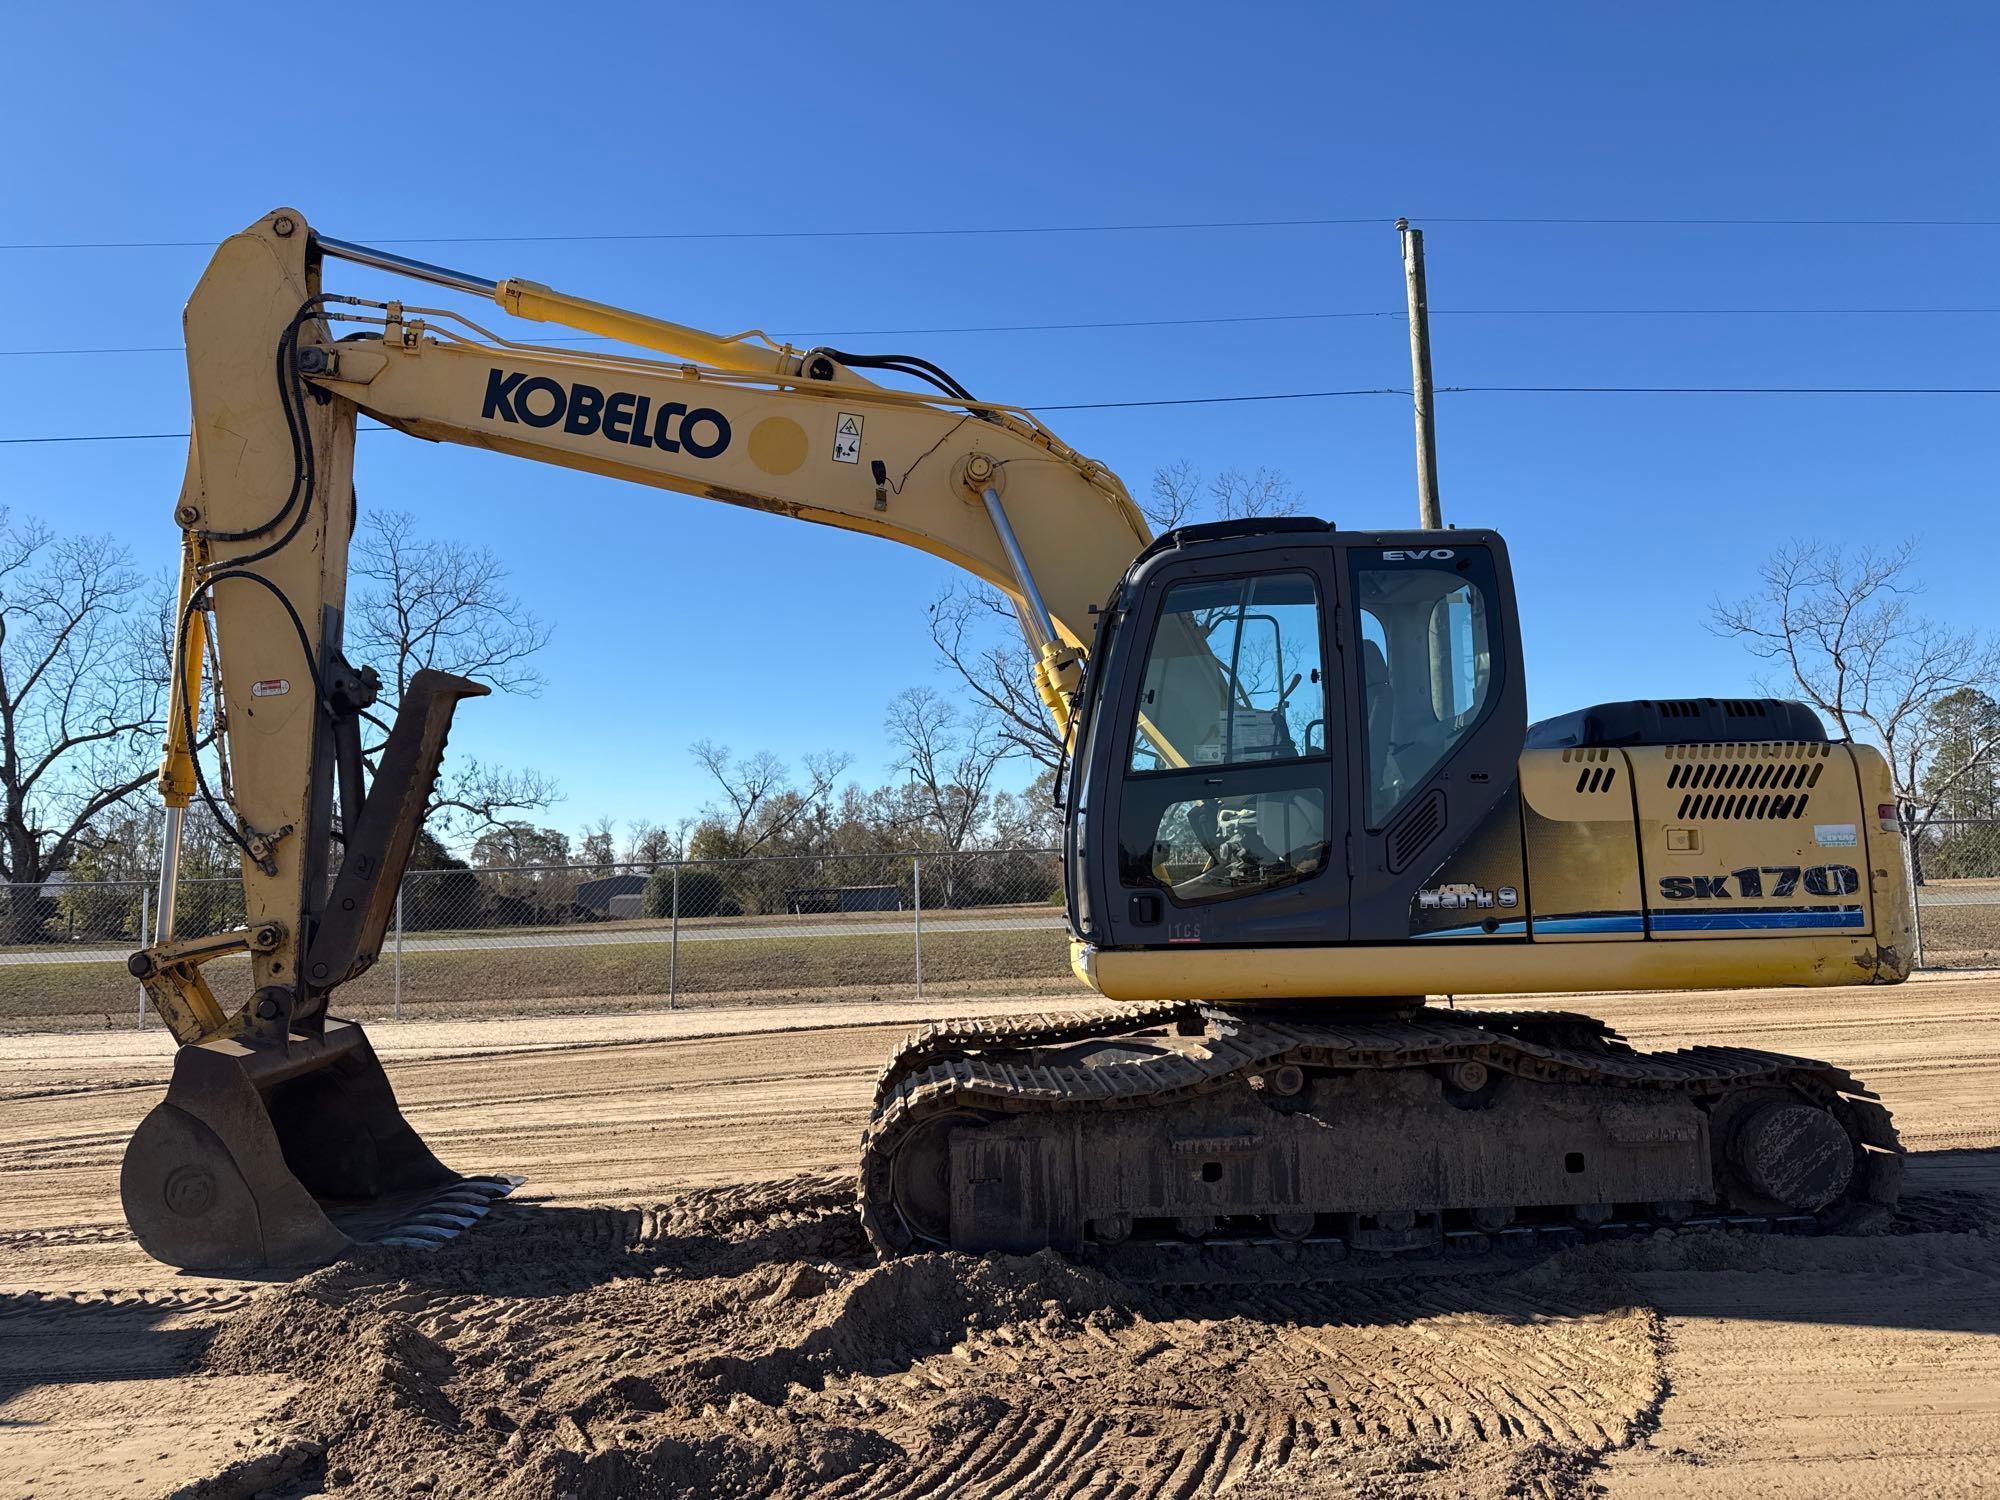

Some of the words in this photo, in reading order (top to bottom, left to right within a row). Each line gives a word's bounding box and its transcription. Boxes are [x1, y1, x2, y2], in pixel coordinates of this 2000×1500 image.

[481, 368, 732, 458] KOBELCO
[1383, 549, 1455, 561] EVO
[1659, 864, 1860, 901] SK170
[1419, 888, 1493, 908] Mark
